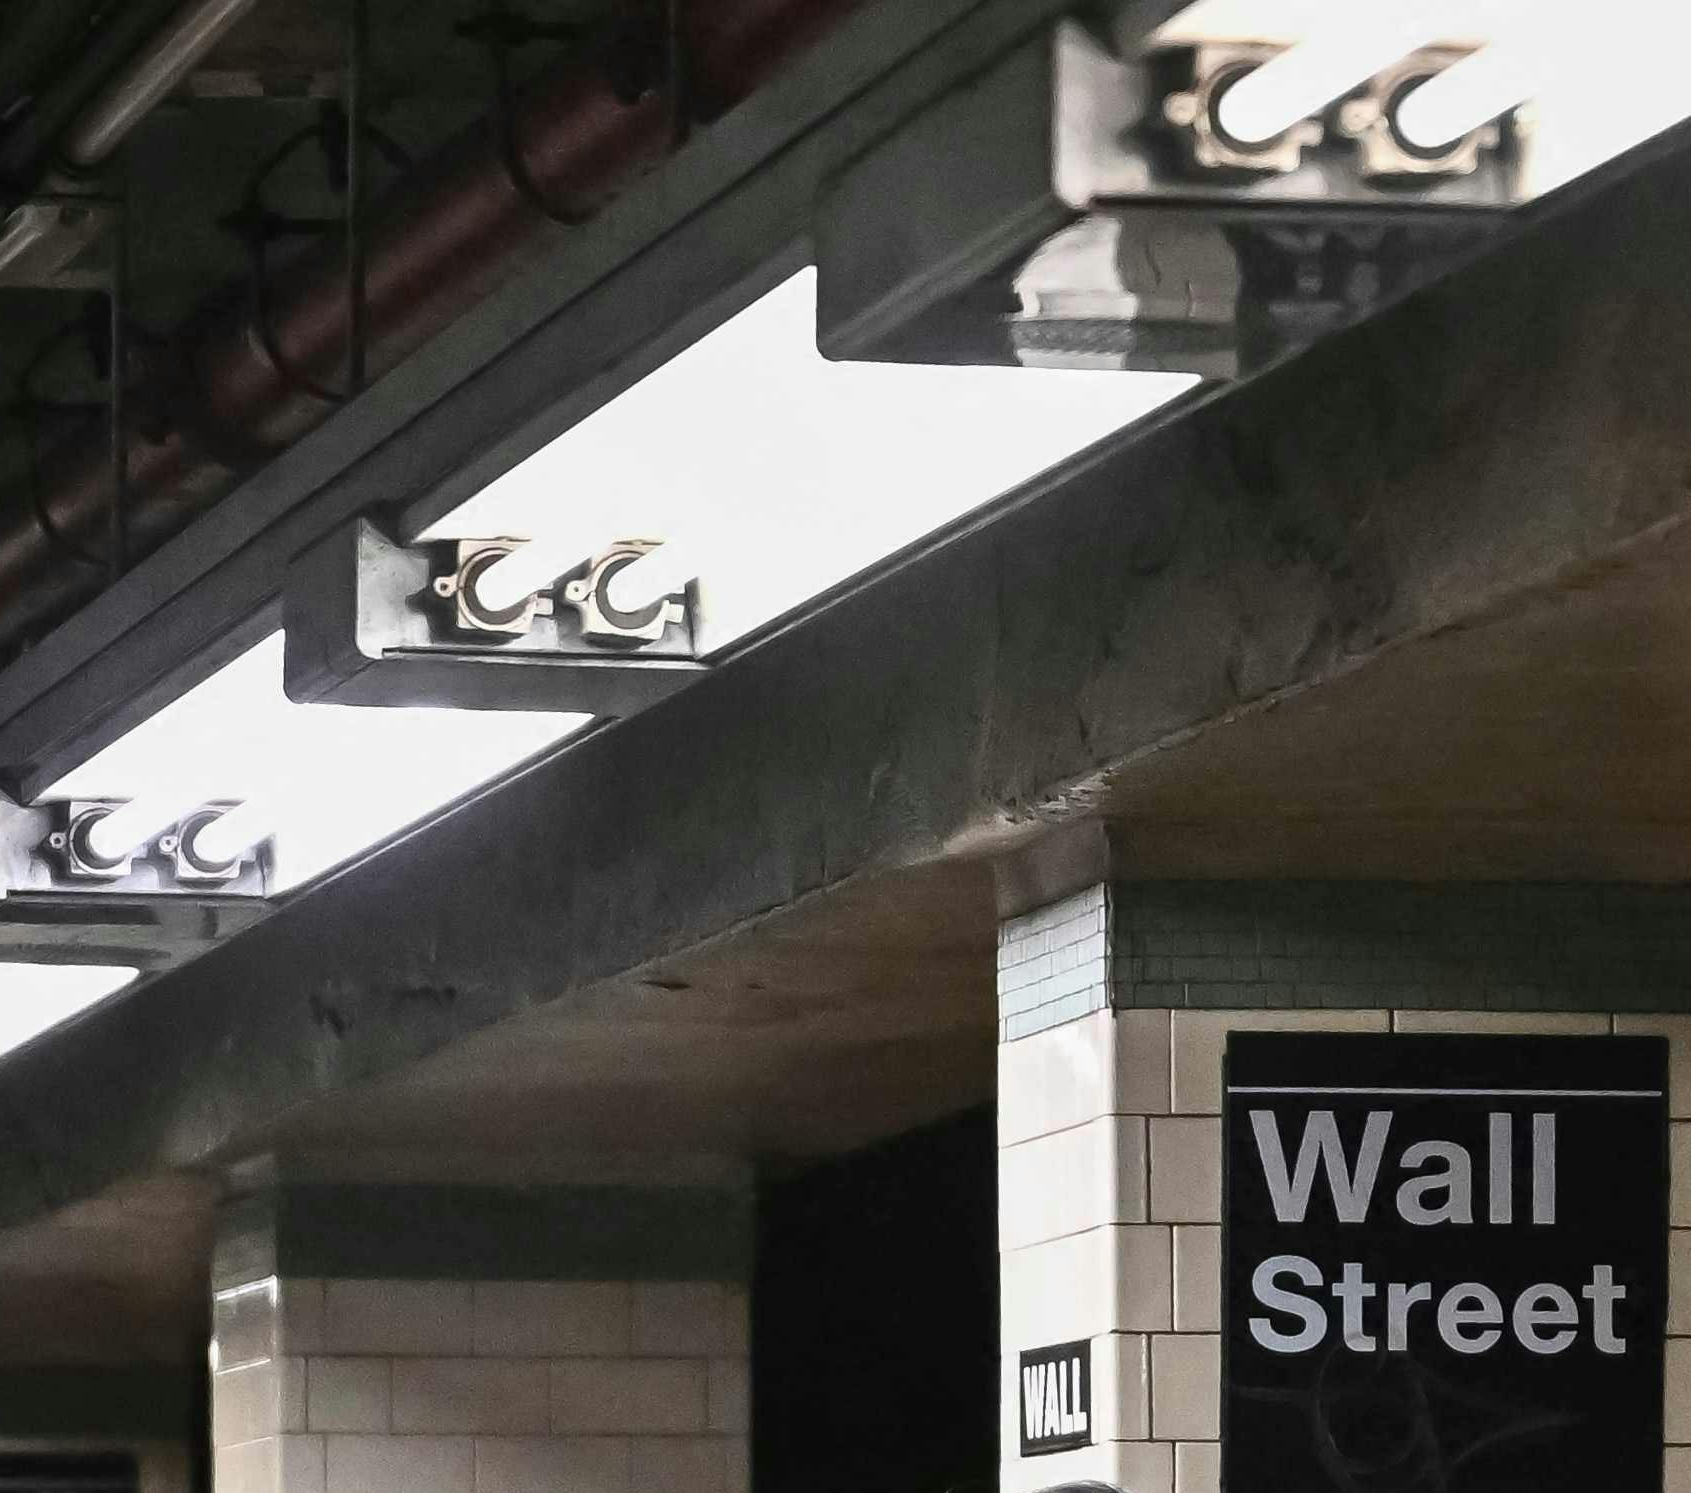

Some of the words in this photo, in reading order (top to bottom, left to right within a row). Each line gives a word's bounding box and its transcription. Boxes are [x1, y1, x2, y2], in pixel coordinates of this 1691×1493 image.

[1248, 1110, 1557, 1226] Wall
[1248, 1254, 1627, 1355] Street
[1023, 1357, 1088, 1440] WALL
